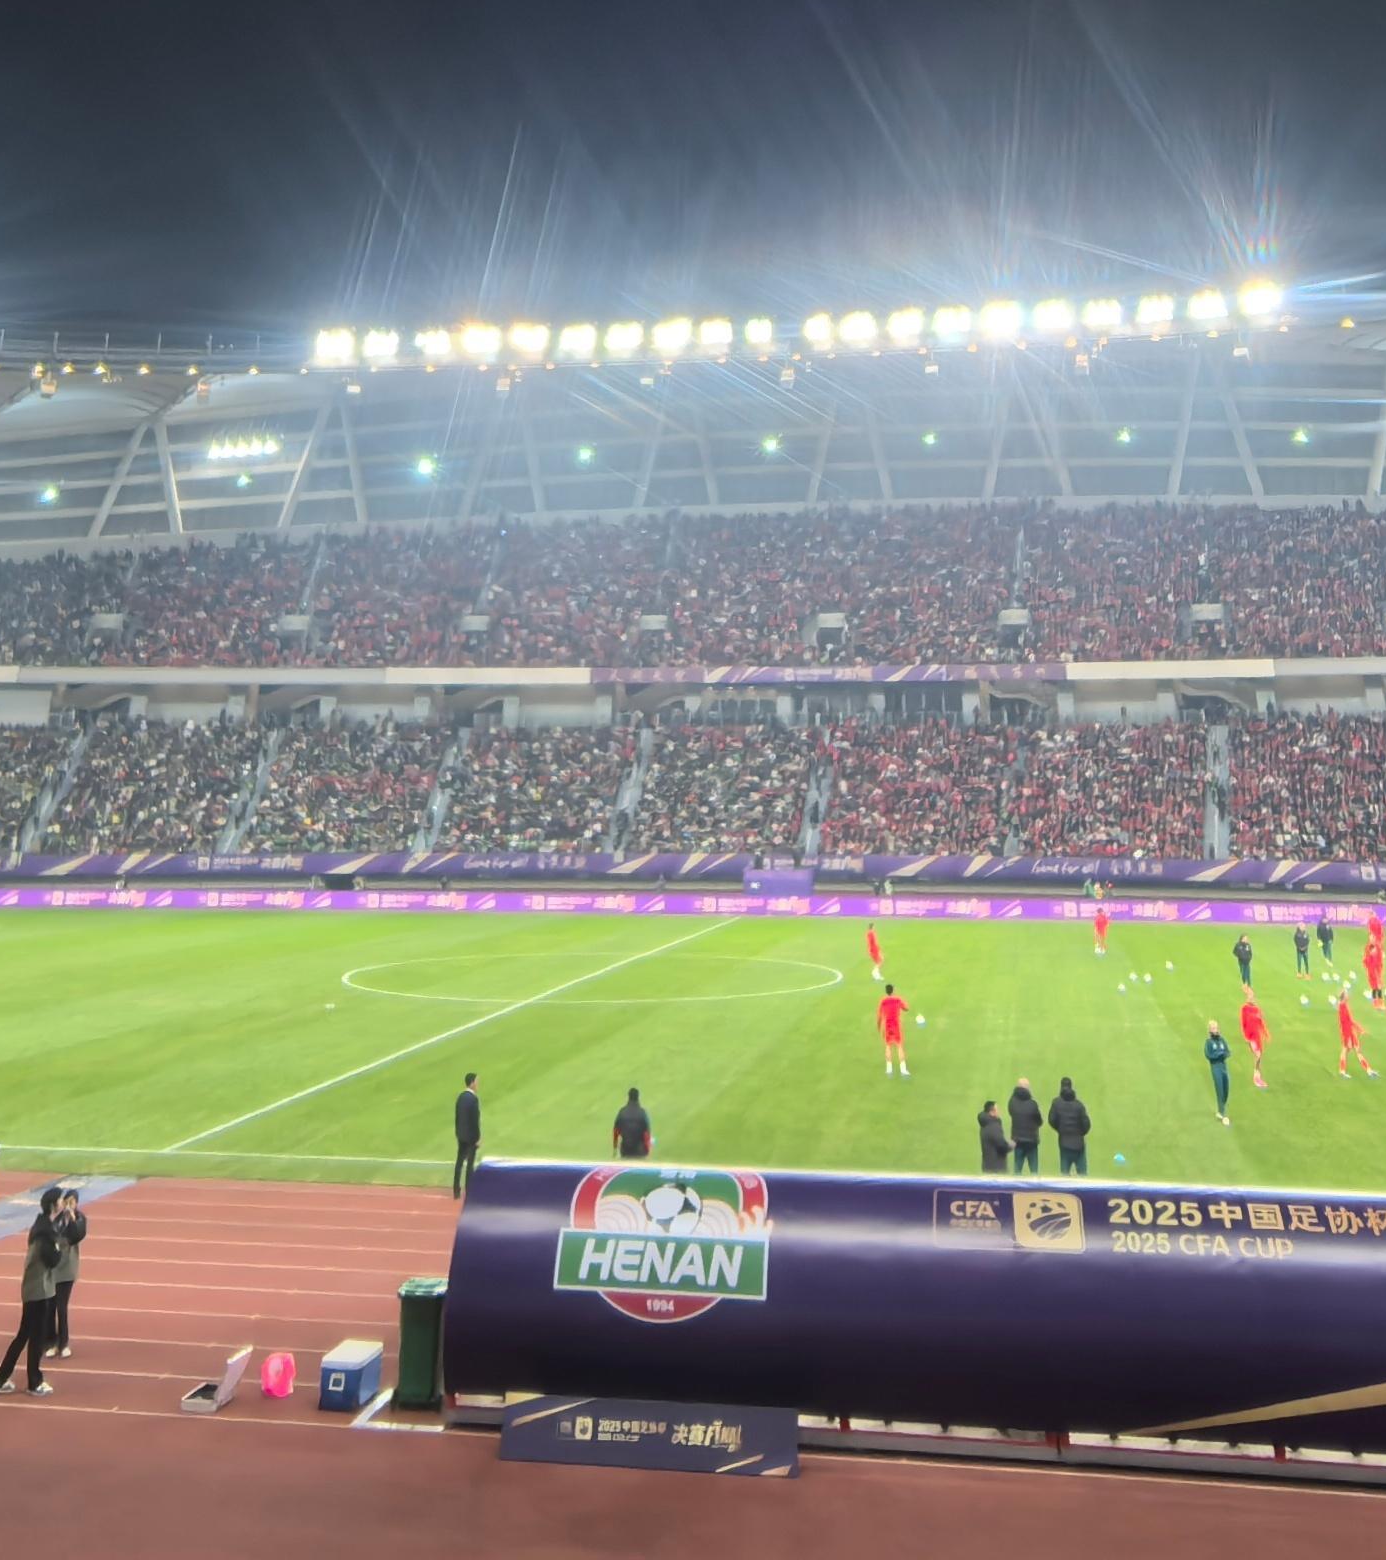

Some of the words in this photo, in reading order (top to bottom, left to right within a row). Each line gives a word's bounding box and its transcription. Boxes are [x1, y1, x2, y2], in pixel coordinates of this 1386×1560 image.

[950, 1201, 996, 1218] CFA
[1112, 1231, 1171, 1255] 2025
[1179, 1234, 1230, 1257] CFA
[1238, 1237, 1294, 1259] CUP
[578, 1238, 744, 1288] HENAN
[646, 1298, 675, 1313] 1994
[671, 1422, 706, 1445] 决赛
